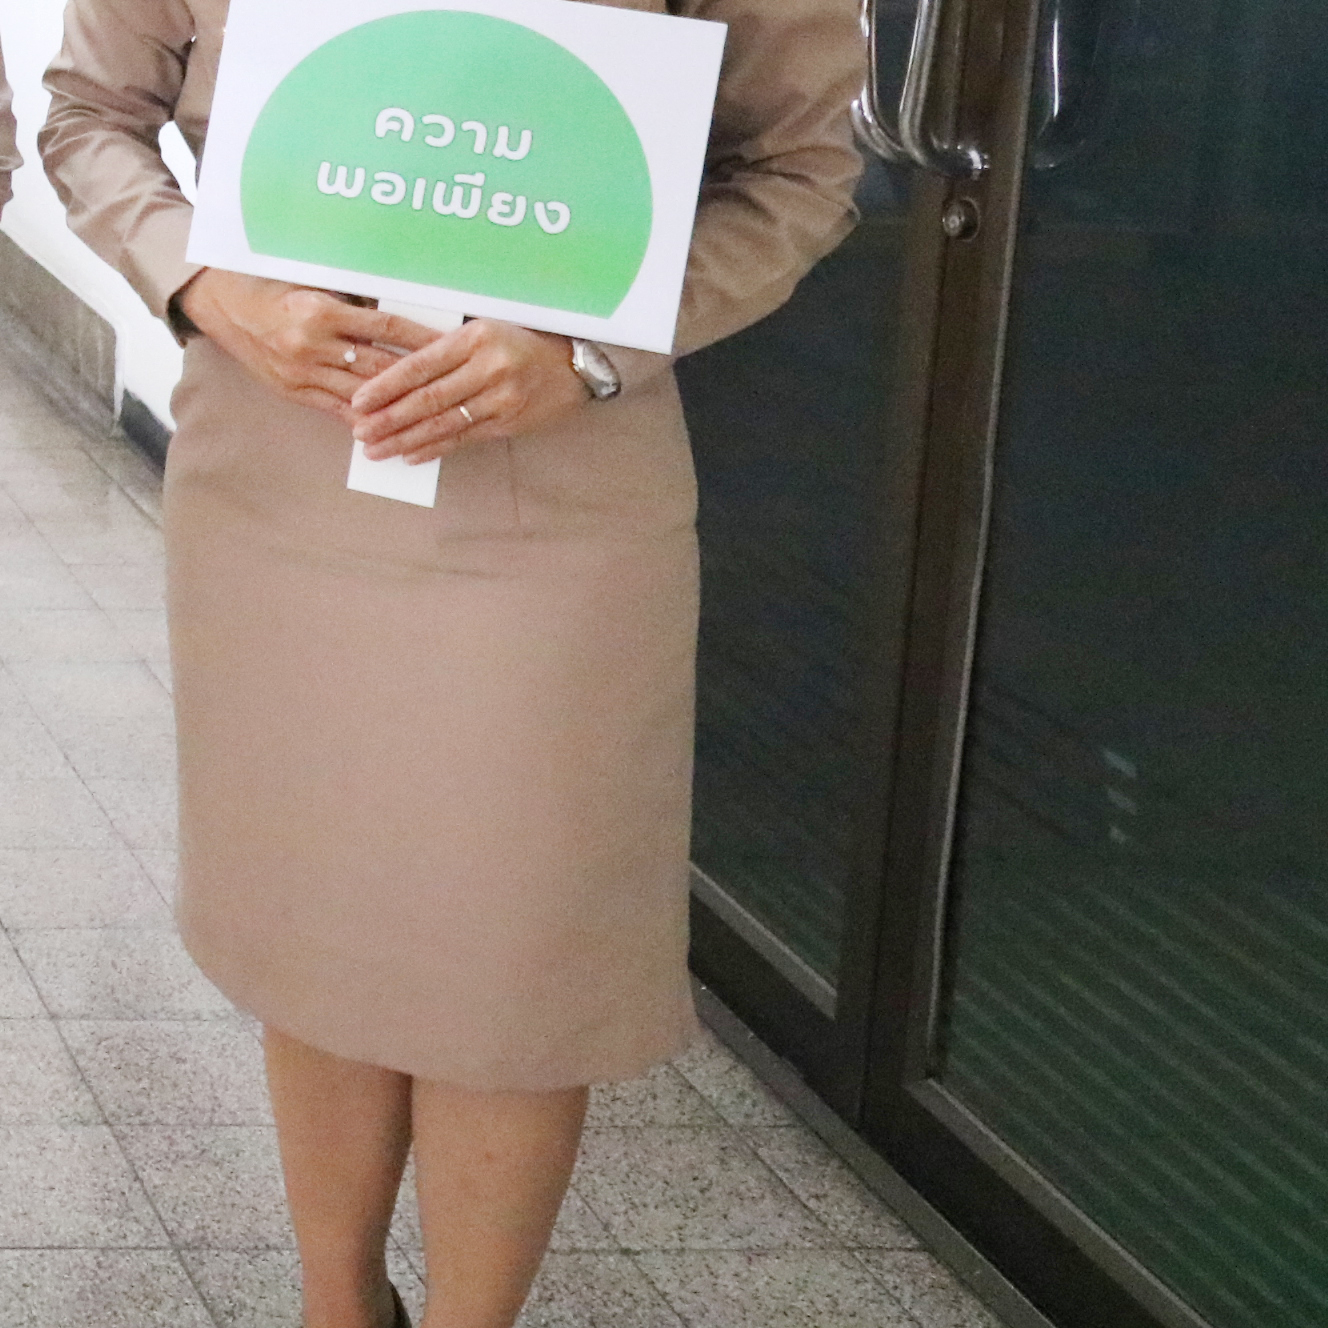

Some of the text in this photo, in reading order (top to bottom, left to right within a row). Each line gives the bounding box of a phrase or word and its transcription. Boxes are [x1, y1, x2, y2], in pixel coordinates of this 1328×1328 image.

[374, 107, 534, 161] ความ
[317, 161, 572, 235] พอเพียง
